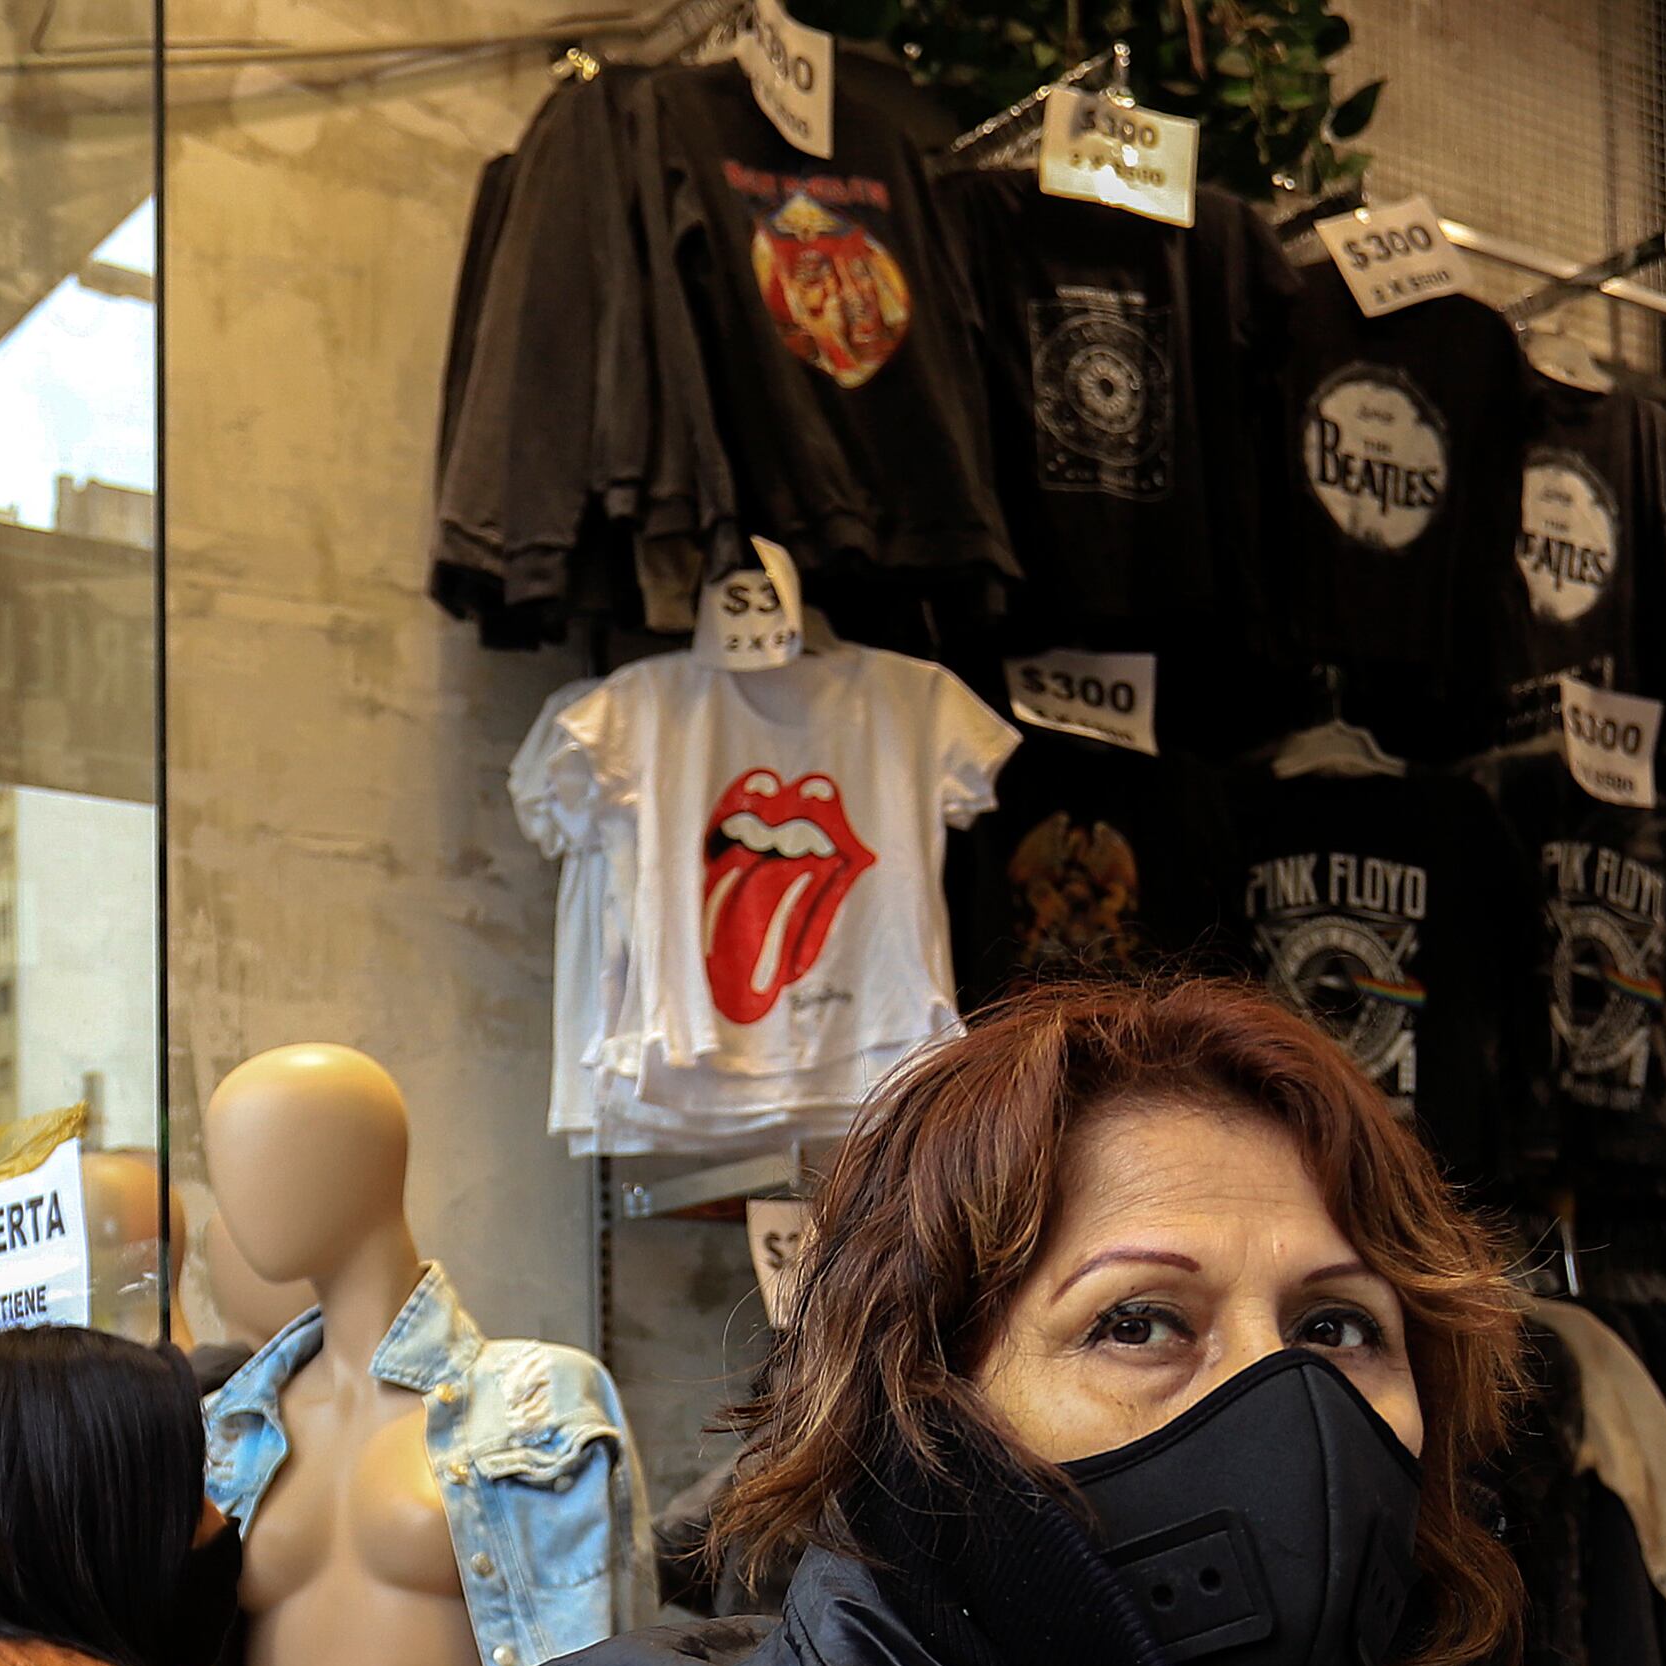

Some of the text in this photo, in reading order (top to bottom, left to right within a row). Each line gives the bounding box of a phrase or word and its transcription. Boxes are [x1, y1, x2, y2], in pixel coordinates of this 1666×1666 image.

[1345, 224, 1433, 272] $300
[1319, 418, 1439, 516] BEATLES
[1519, 532, 1607, 592] EATLES
[1022, 666, 1135, 714] $300
[1245, 852, 1427, 920] PINK FLOYD
